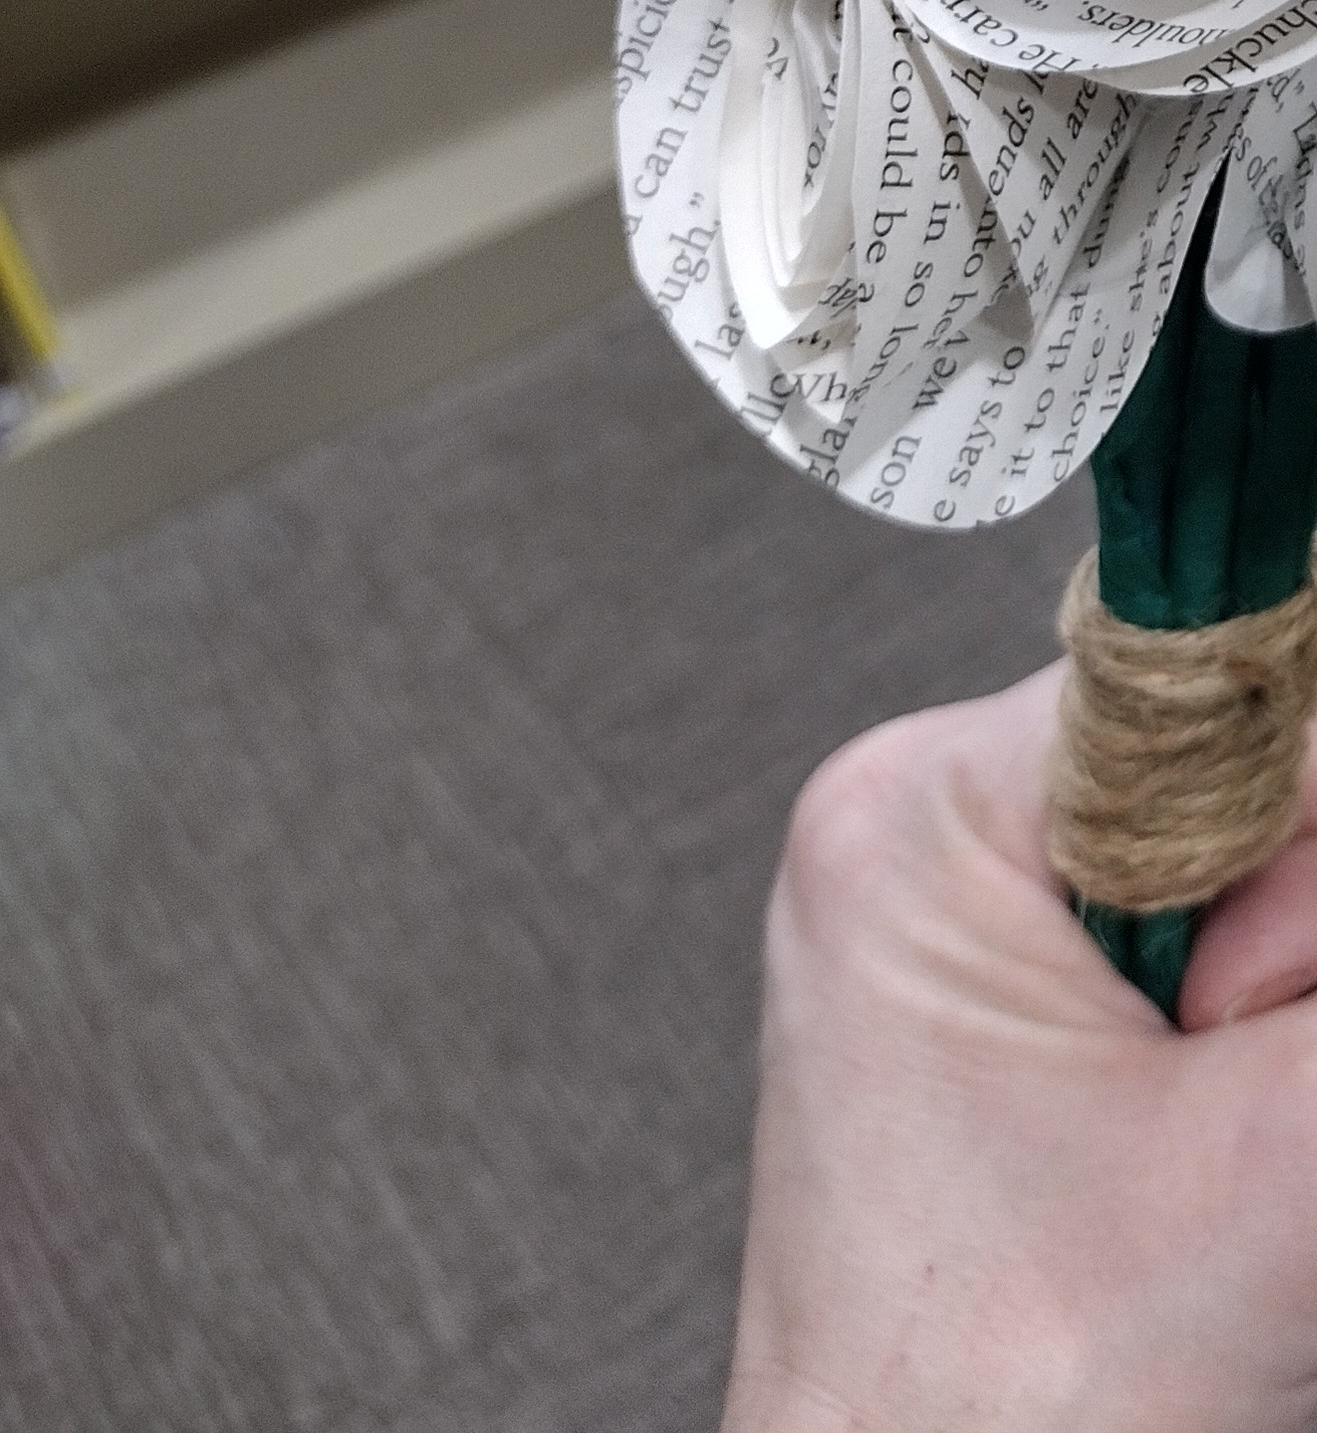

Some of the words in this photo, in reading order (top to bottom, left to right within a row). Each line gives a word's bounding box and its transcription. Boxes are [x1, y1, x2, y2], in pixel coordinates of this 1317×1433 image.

[634, 126, 690, 200] can
[669, 17, 733, 113] trust
[879, 58, 919, 190] could
[1038, 136, 1067, 201] all
[866, 207, 909, 264] be
[923, 200, 962, 265] in
[904, 261, 934, 308] so
[950, 399, 1002, 487] says
[988, 346, 1025, 387] to
[1001, 446, 1035, 478] it
[1024, 386, 1055, 434] to
[1046, 281, 1092, 373] that
[870, 433, 923, 509] son
